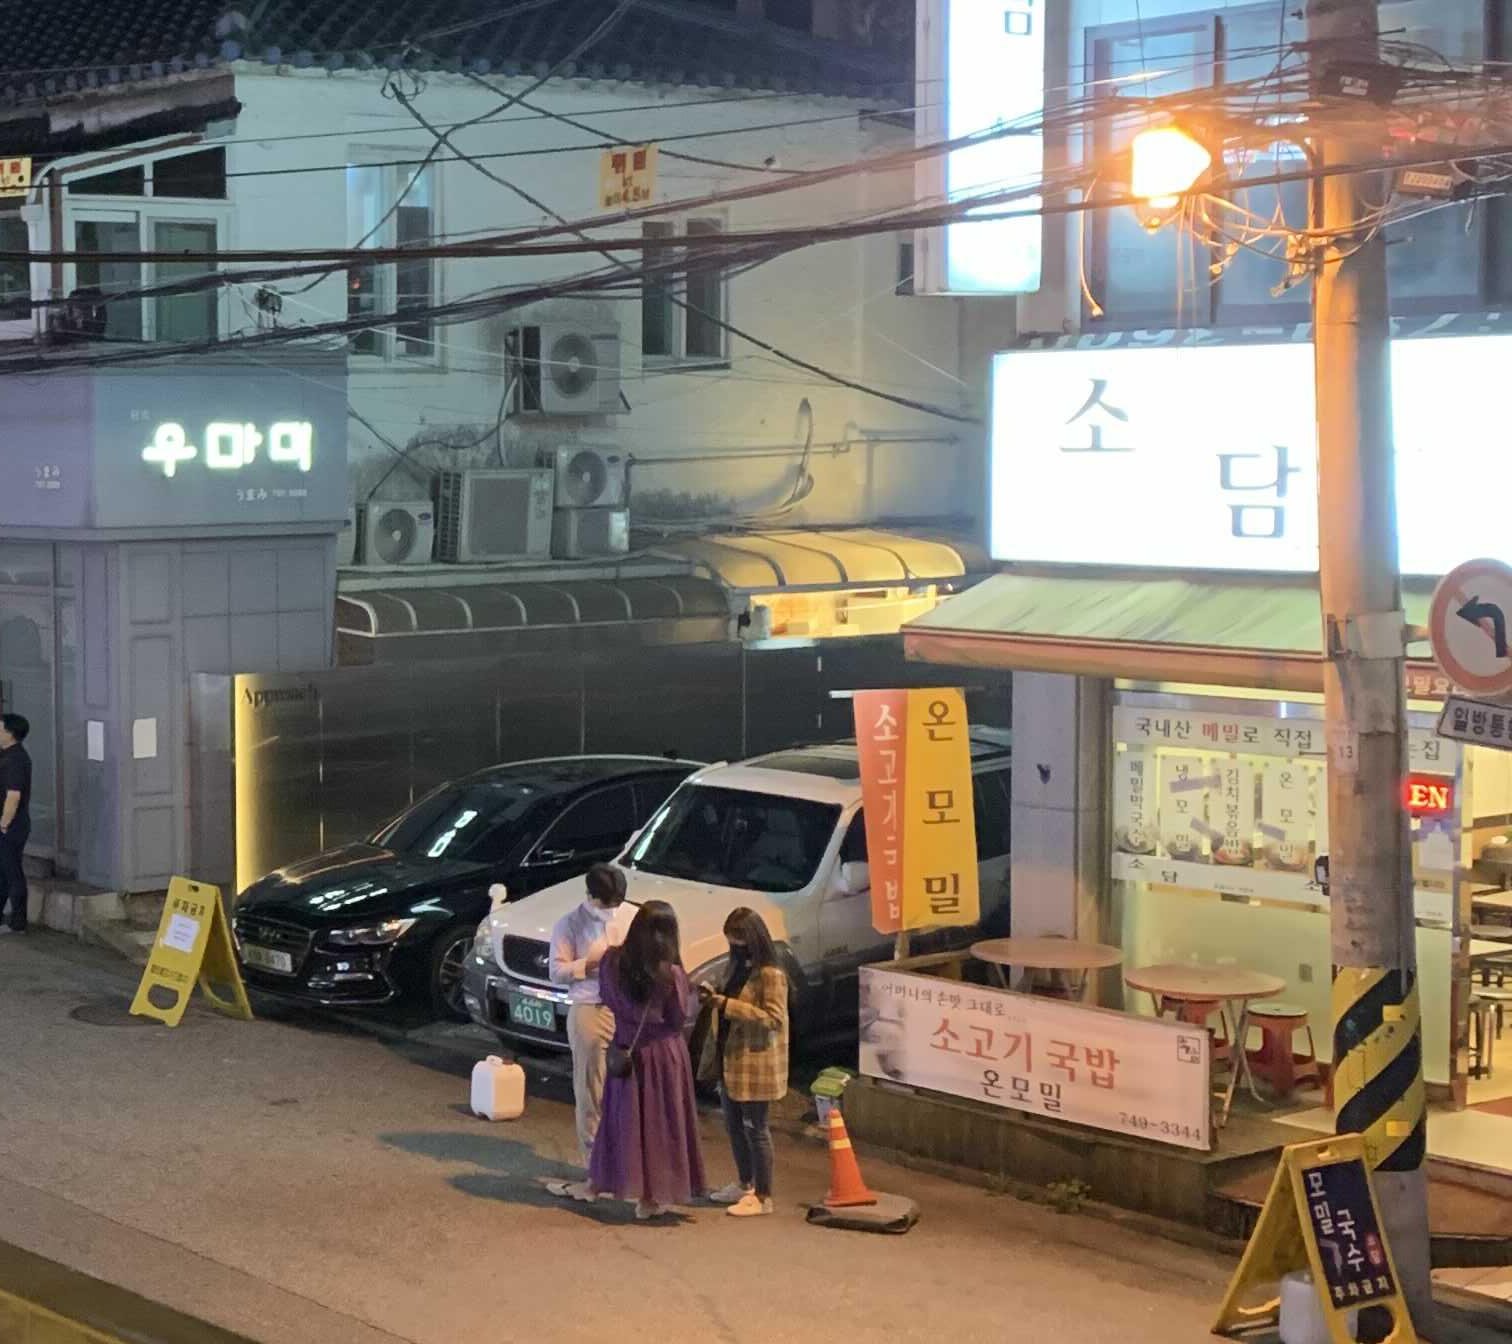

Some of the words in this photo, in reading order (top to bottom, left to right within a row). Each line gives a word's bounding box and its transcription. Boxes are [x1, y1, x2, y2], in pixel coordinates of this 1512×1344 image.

[141, 421, 313, 478] 우마미
[1059, 377, 1302, 540] 소담
[1136, 717, 1191, 740] 국내산
[1202, 722, 1260, 745] 메밀로
[1273, 727, 1313, 750] 직접
[1453, 706, 1512, 743] 일방통
[922, 700, 962, 915] 온모밀
[513, 1004, 553, 1027] 4019
[881, 983, 933, 1003] 어머니의
[929, 1017, 1033, 1074] 소고기
[1046, 1039, 1121, 1090] 국밥
[981, 1068, 1063, 1113] 온모밀
[1308, 1171, 1336, 1236] 모밀
[1336, 1207, 1365, 1273] 국수
[1334, 1275, 1390, 1302] 주차금지
